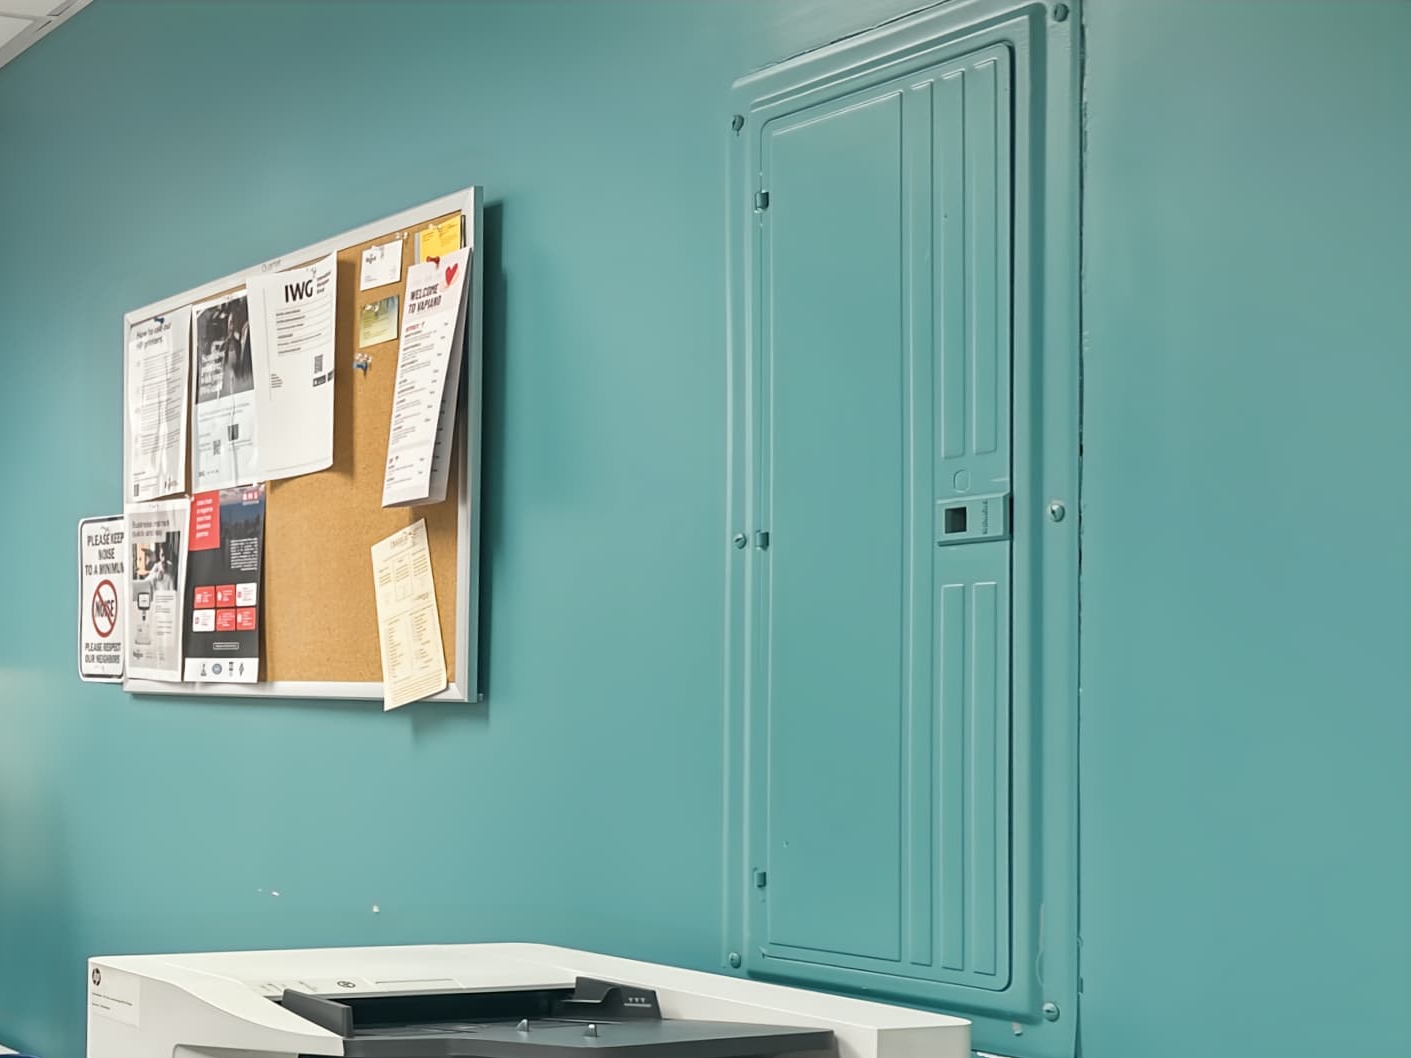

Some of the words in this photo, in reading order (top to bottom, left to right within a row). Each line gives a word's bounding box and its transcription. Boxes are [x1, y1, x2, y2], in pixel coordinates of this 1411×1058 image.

[285, 279, 313, 303] IWG
[410, 283, 439, 301] WELCOME
[409, 303, 417, 314] TO
[417, 295, 442, 312] VAPIANO
[87, 533, 110, 547] PLEASE
[110, 532, 124, 544] KEEP
[98, 548, 115, 560] NOISE
[85, 564, 93, 576] TO
[95, 599, 115, 618] NOISE
[85, 642, 102, 652] PLEASE
[103, 642, 121, 652] RESPECT
[85, 655, 95, 664] OUR
